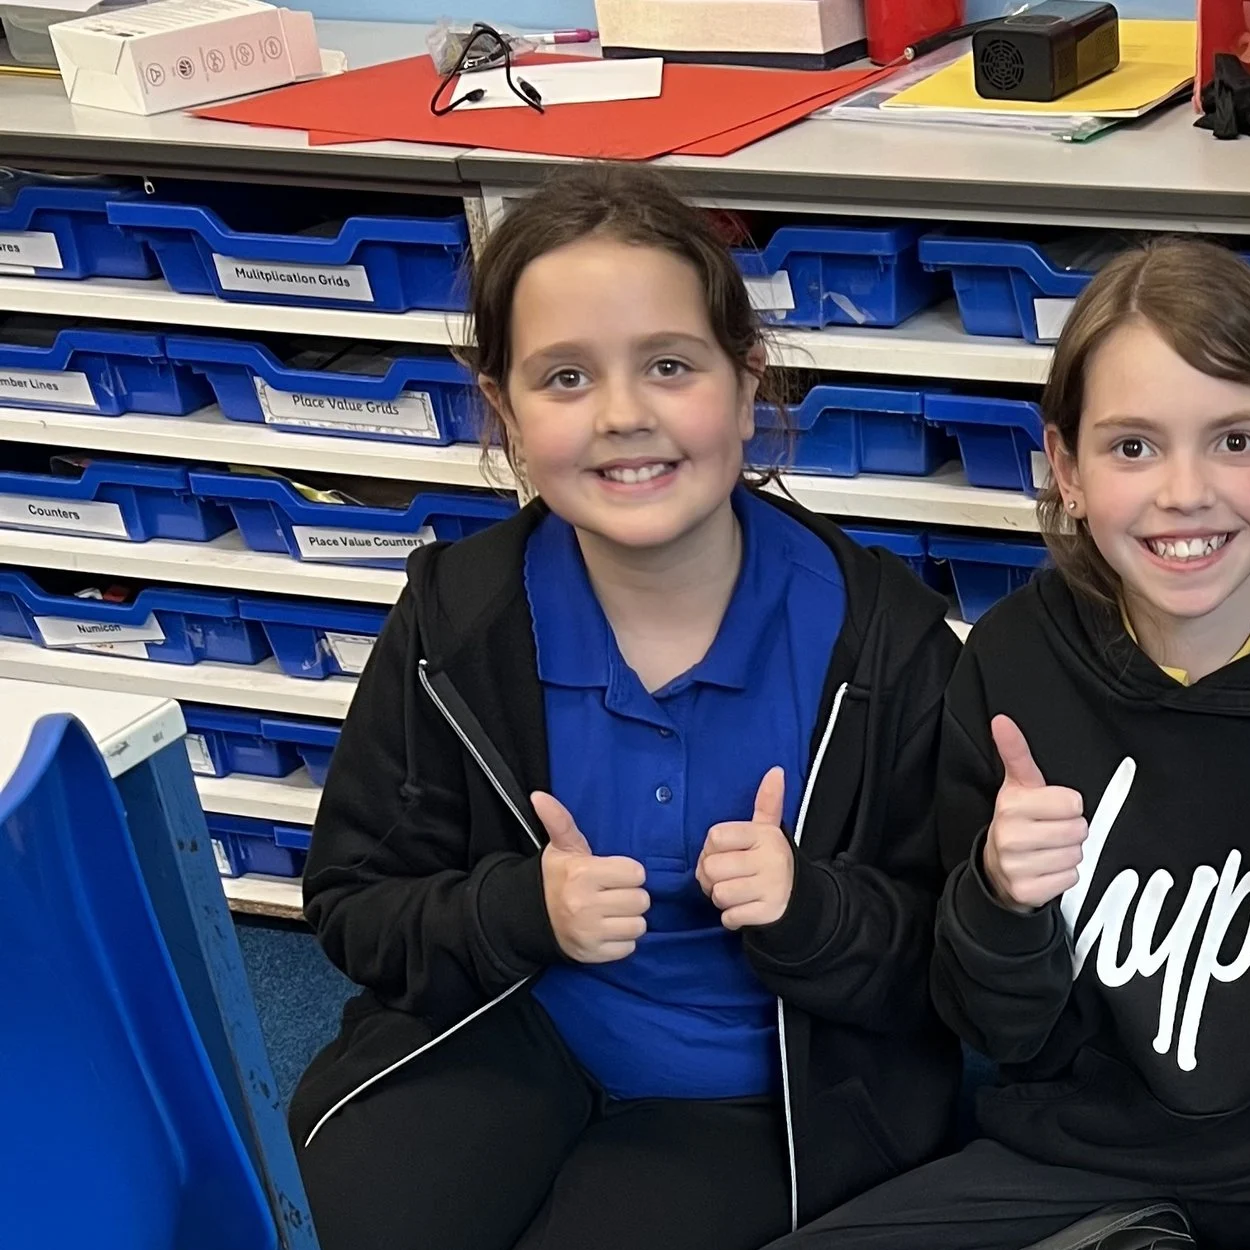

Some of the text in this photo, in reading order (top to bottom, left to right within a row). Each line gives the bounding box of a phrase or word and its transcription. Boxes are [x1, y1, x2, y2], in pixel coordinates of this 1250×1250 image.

[318, 274, 350, 287] Grids
[29, 378, 59, 391] Lines
[292, 394, 399, 415] Place Value Grids
[28, 504, 80, 520] Counters
[308, 536, 424, 547] Place Value Counters
[77, 624, 122, 633] Numicon
